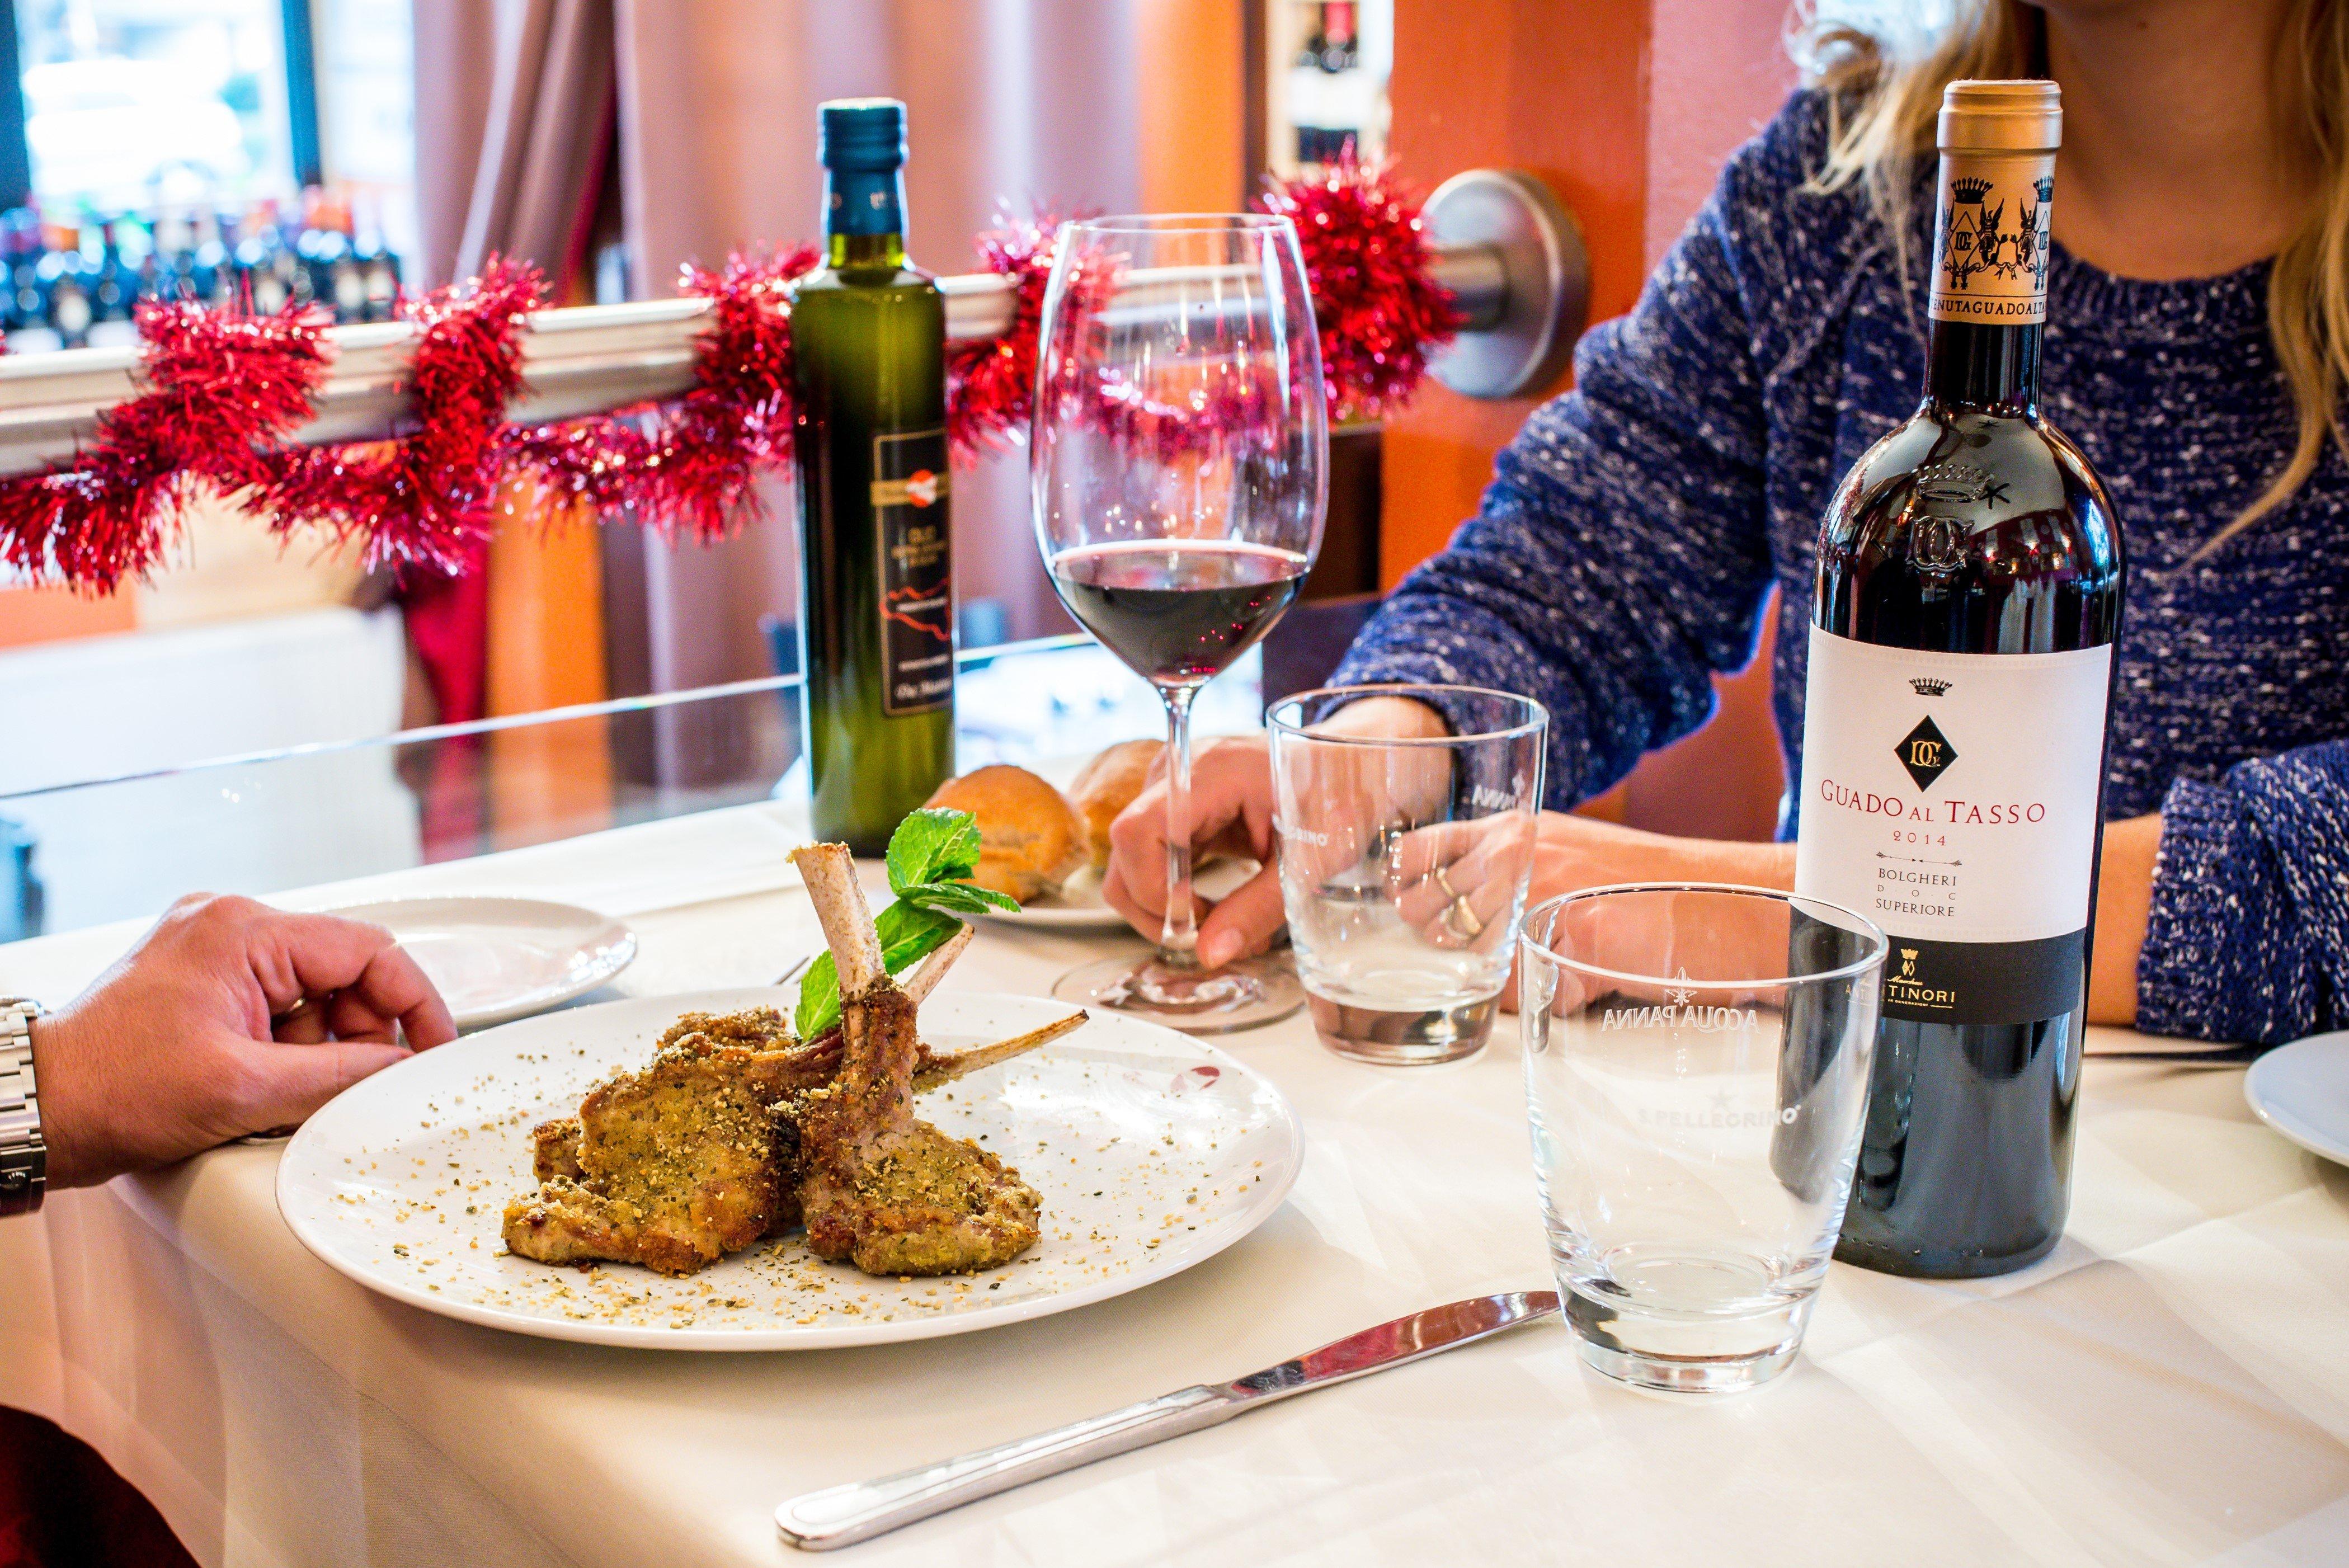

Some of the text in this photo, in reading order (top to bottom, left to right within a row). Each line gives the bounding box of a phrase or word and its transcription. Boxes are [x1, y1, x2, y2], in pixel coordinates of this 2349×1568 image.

[1821, 779, 2045, 825] GUADO AL TASSO
[1893, 830, 1946, 846] 2014
[1879, 868, 1957, 887] BOLGHERI
[1876, 898, 1955, 917] SUPERIORE
[1889, 985, 1955, 1002] TINORI
